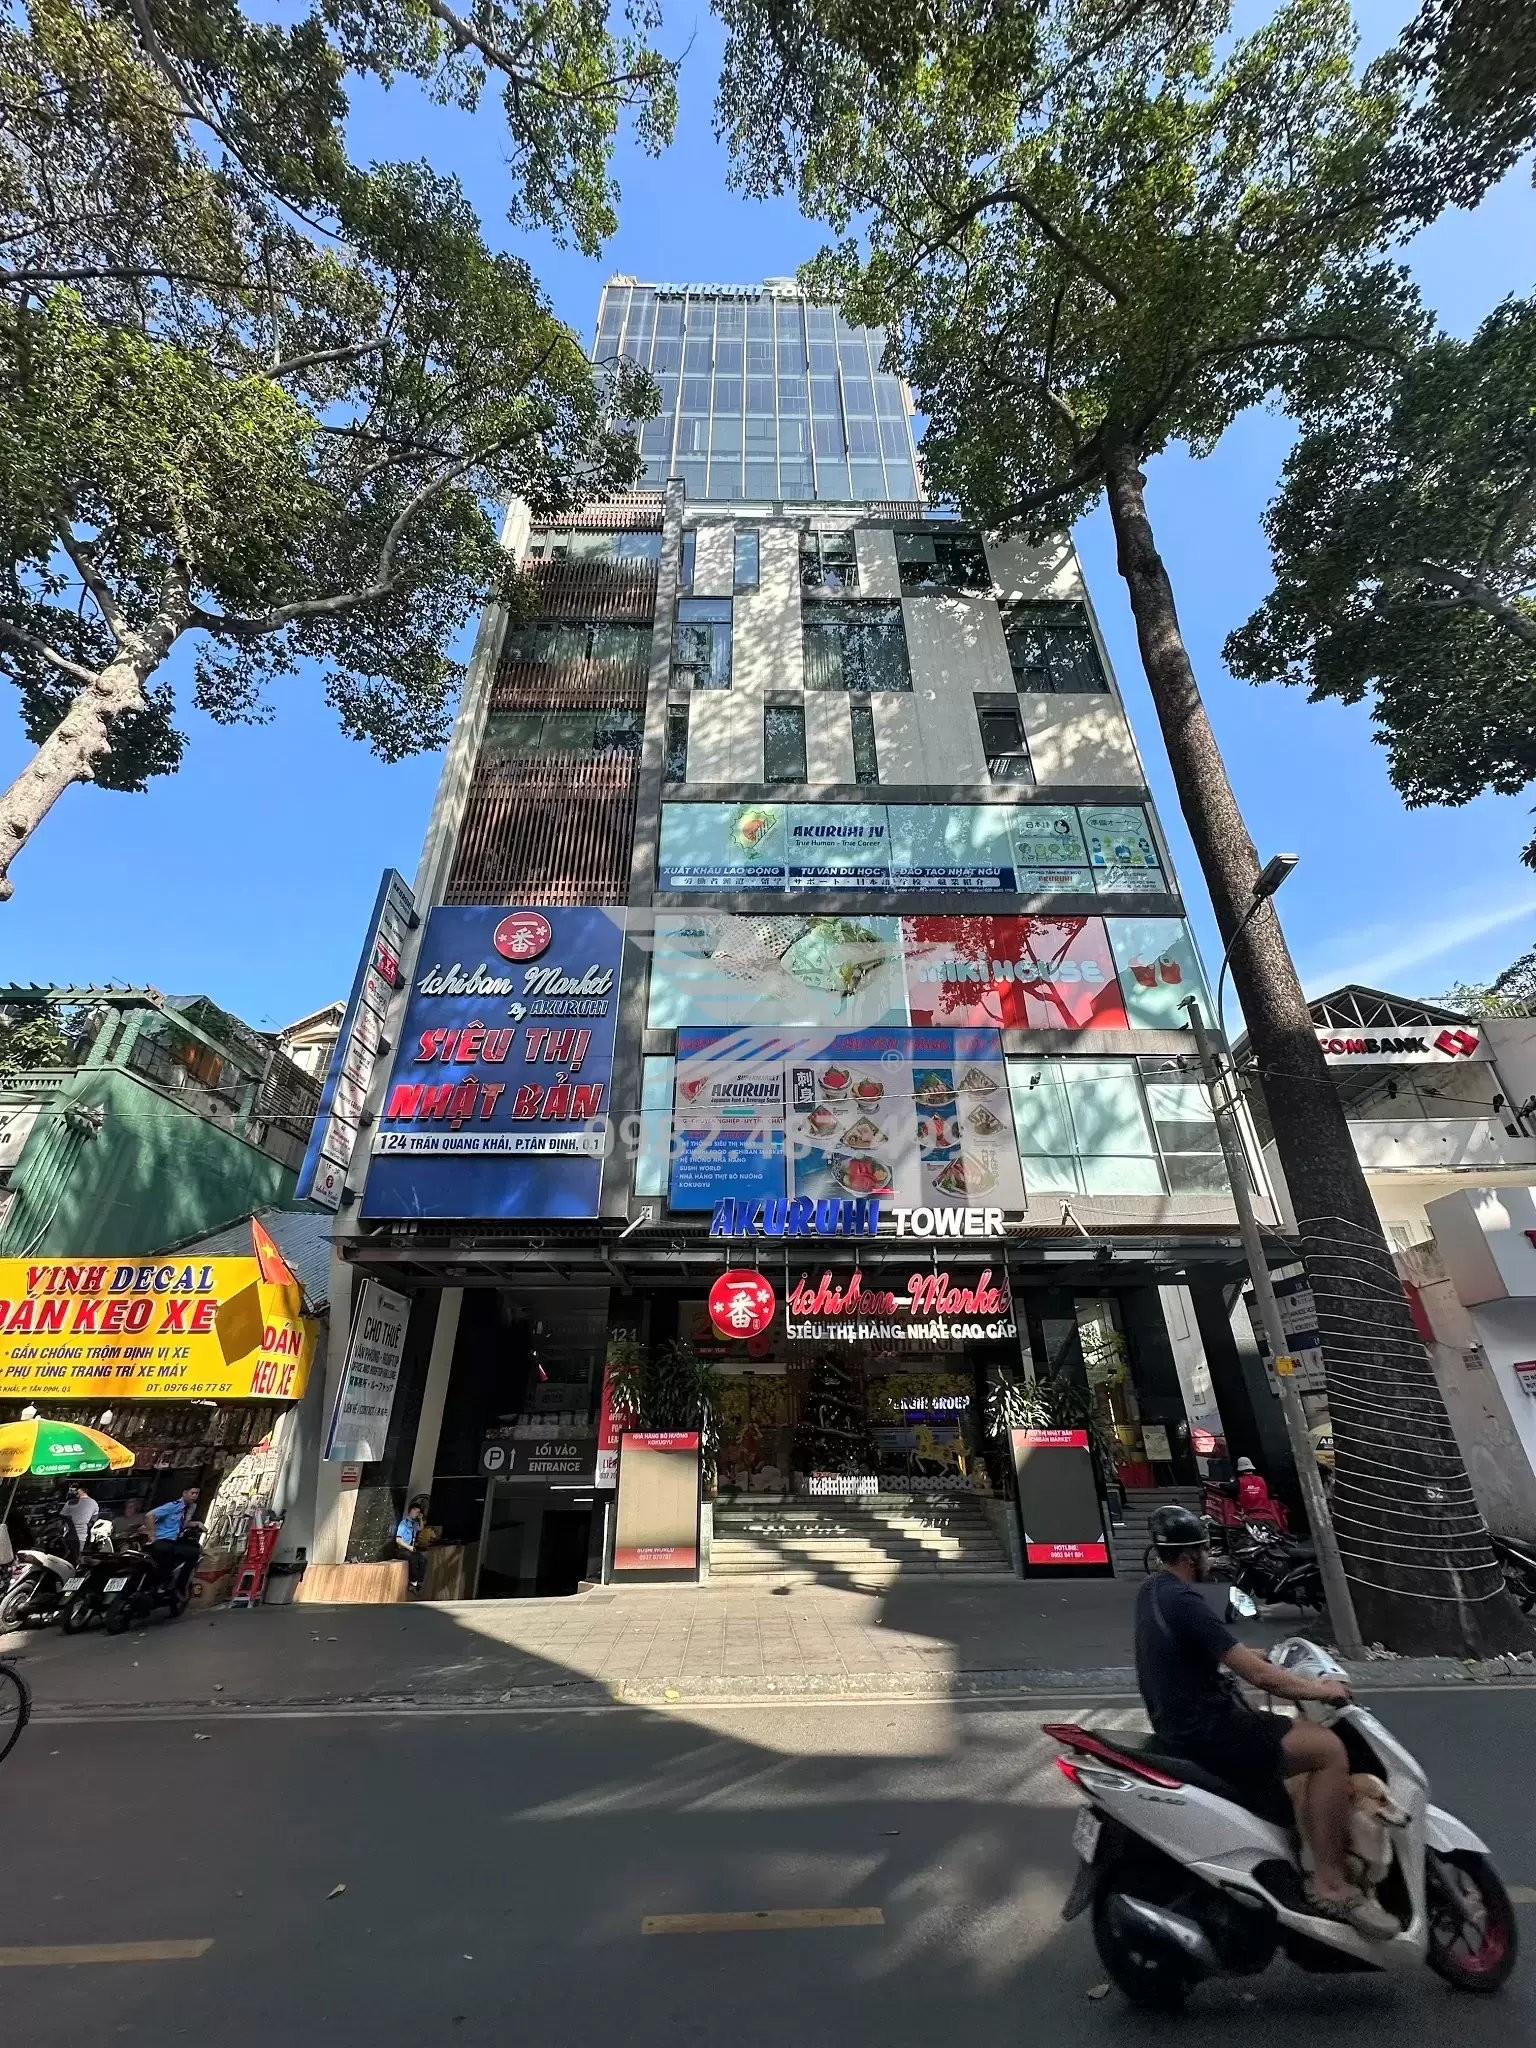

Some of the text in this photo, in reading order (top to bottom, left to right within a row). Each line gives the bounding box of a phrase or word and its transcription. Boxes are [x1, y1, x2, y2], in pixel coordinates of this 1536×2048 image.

[793, 825, 864, 838] AKURUHI
[723, 867, 745, 875] LAO
[508, 921, 538, 953] 一番
[522, 963, 614, 996] Market
[992, 959, 1105, 983] HOUSE
[529, 1000, 609, 1018] AKURUHI
[414, 1019, 515, 1064] SIÊU
[525, 1028, 592, 1071] THỊ
[386, 1070, 604, 1129] NHẬT BẢN
[711, 1083, 780, 1097] AKURUHI
[380, 1134, 407, 1150] 124
[442, 1138, 480, 1151] QUANG
[515, 1136, 546, 1150] P.TÂN
[549, 1138, 579, 1152] ĐỊNH,
[709, 1197, 1006, 1237] AKURUHI TOWER
[27, 1265, 215, 1295] VINH DECAL
[907, 1268, 1013, 1315] Market
[70, 1299, 154, 1334] KEO
[156, 1299, 219, 1334] XE
[724, 1281, 758, 1328] 一番
[261, 1322, 302, 1356] DÁN
[364, 1317, 401, 1348] CHO THUÊ
[787, 1320, 822, 1340] SIÊU
[858, 1320, 902, 1339] HÀNG
[907, 1318, 949, 1343] NHẬT
[951, 1322, 984, 1339] CAO
[985, 1318, 1018, 1339] CẤP
[11, 1343, 190, 1361] GẮN CHỐNG TRỘM ĐỊNH VỊ XE
[5, 1365, 31, 1380] PHỤ
[70, 1365, 112, 1377] TRANG
[115, 1363, 136, 1377] TRÍ
[137, 1365, 155, 1377] XE
[157, 1363, 188, 1377] MÁY
[250, 1360, 296, 1395] KEO XE
[163, 1383, 189, 1393] 0976
[189, 1383, 203, 1393] 46
[204, 1383, 217, 1393] 77
[219, 1383, 233, 1393] 87
[535, 1443, 577, 1455] LỐI VÀO
[528, 1462, 580, 1472] ENTRANCE
